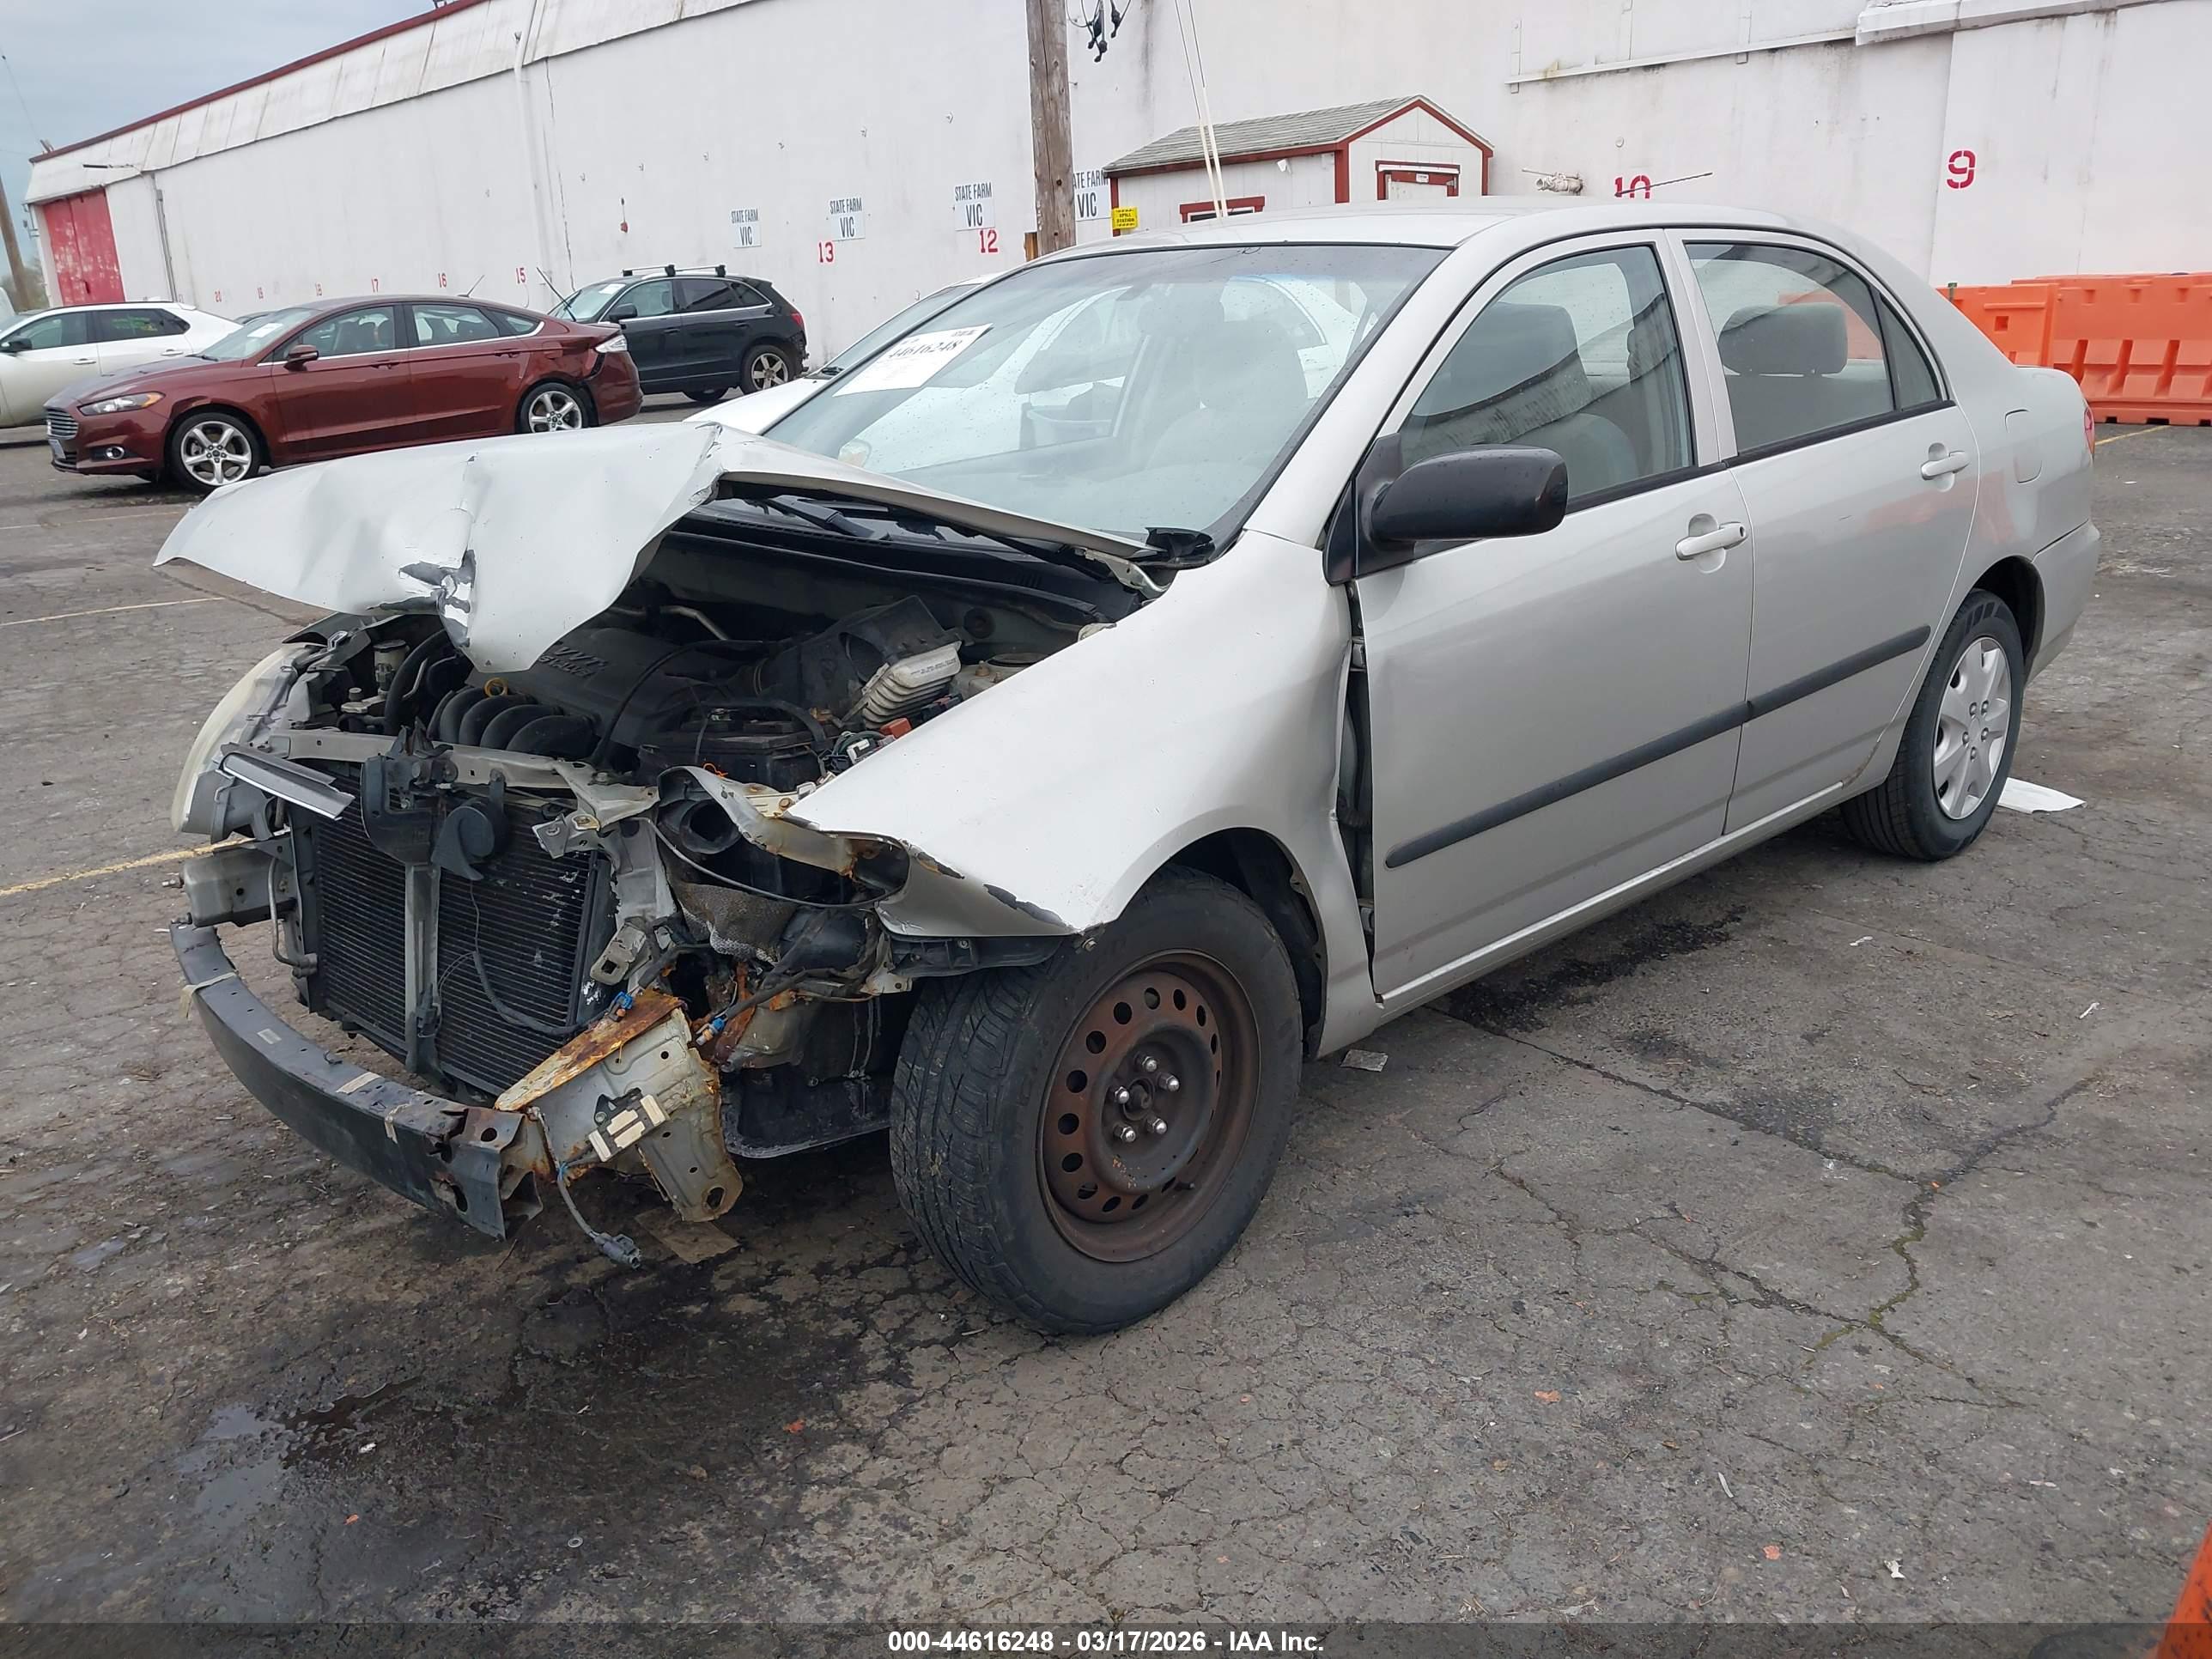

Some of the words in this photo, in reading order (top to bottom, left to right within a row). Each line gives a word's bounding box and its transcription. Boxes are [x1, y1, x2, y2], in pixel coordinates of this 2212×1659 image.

[1073, 172, 1085, 189] ATE
[1086, 169, 1109, 188] FARM
[1946, 149, 1976, 190] 9
[954, 185, 972, 202] STATE
[973, 181, 993, 199] FARM
[830, 198, 846, 215] STATE
[846, 197, 863, 213] FARM
[1077, 191, 1097, 218] VIC
[731, 210, 744, 224] STATE
[744, 208, 759, 222] FARM
[965, 203, 983, 228] VIC
[739, 226, 753, 246] VIC
[840, 216, 855, 238] VIC
[980, 229, 999, 253] 12
[818, 241, 835, 263] 13
[371, 277, 380, 293] 17
[438, 272, 447, 289] 16
[515, 267, 526, 284] 15
